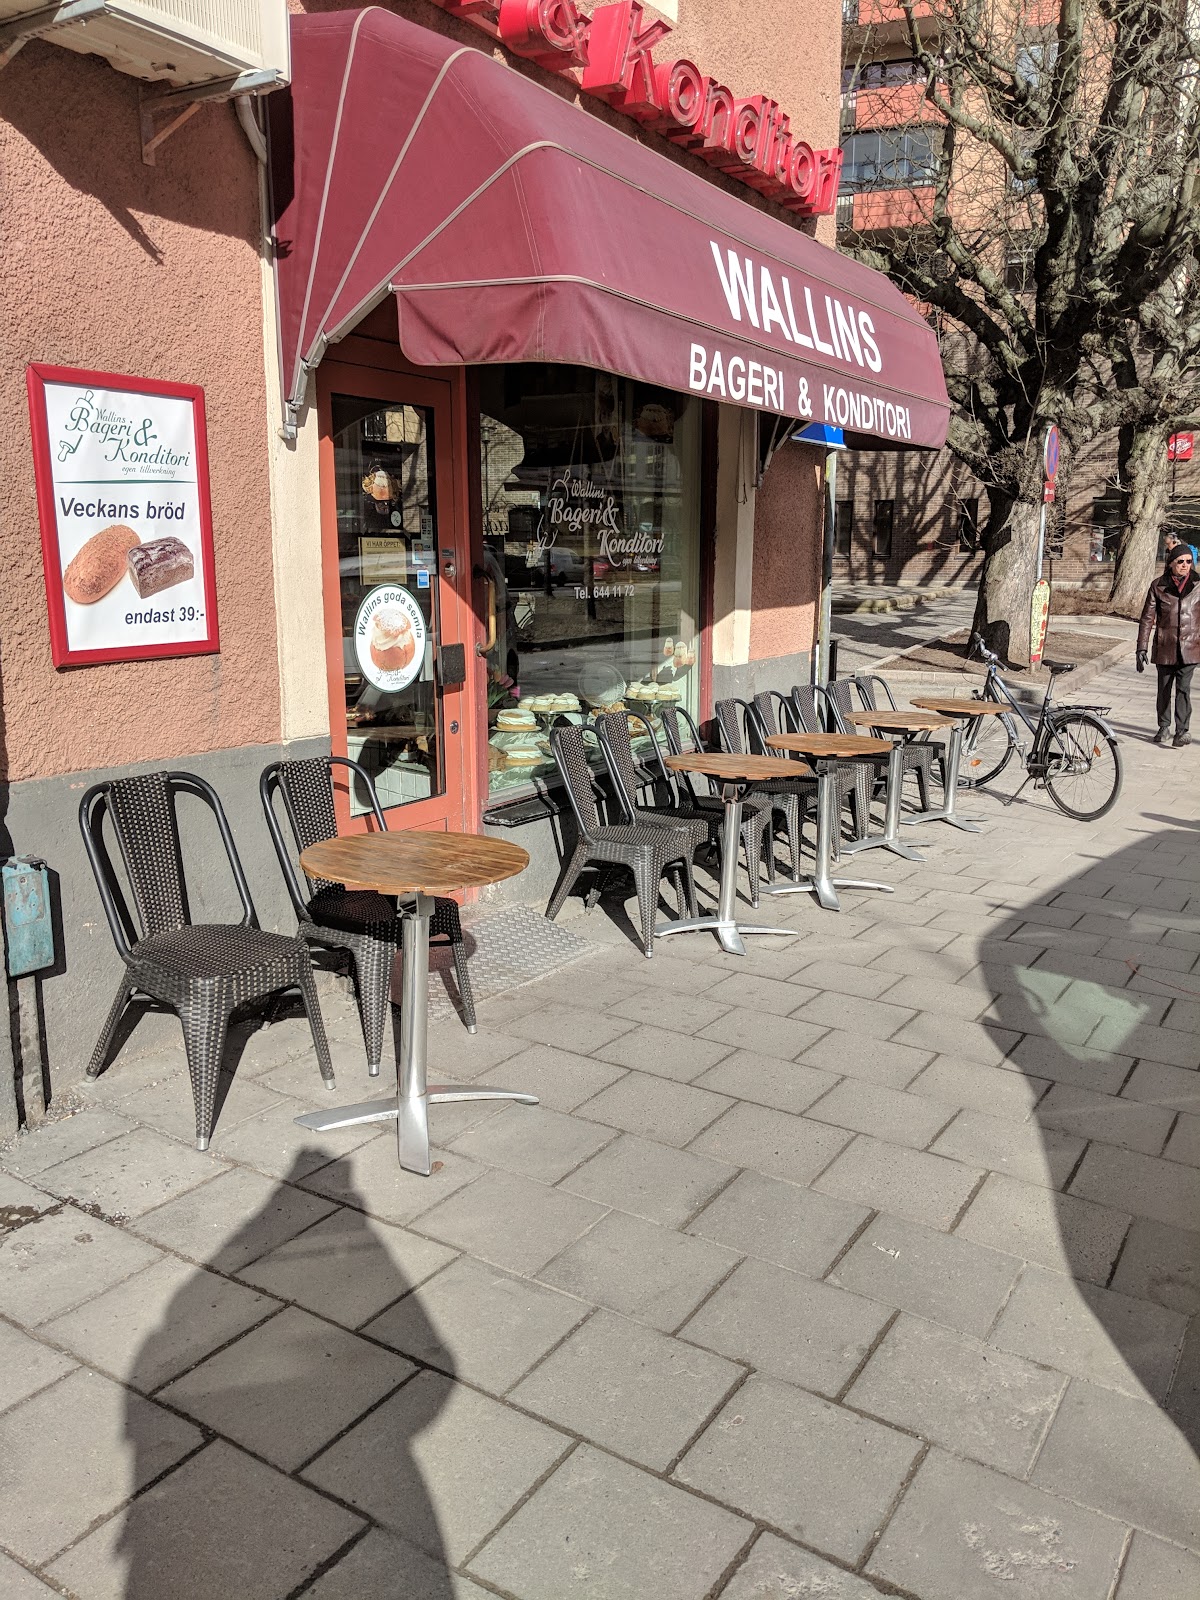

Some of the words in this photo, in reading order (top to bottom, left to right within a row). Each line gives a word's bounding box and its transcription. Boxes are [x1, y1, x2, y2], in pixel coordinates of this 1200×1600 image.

[582, 0, 843, 217] Konditori
[709, 240, 883, 374] WALLINS
[688, 343, 785, 412] BAGERI
[797, 376, 814, 418] &
[822, 383, 912, 440] KONDITORI
[64, 406, 134, 444] Bageri
[133, 418, 158, 447] &
[95, 407, 127, 424] Wallins
[104, 437, 191, 467] Konditori
[121, 466, 137, 475] egen
[139, 464, 176, 479] tillverkning
[571, 479, 606, 499] Wallins
[60, 497, 140, 519] Veckans
[146, 500, 186, 520] bröd
[547, 497, 603, 532] Bageri
[602, 496, 621, 534] &
[596, 528, 665, 567] Konditori
[573, 586, 591, 600] Tel.
[593, 585, 610, 599] 644
[612, 585, 622, 598] 11
[624, 584, 635, 597] 72
[124, 607, 176, 625] endast
[178, 606, 205, 622] 39:-
[358, 595, 382, 636] Wallins
[383, 592, 407, 605] goda
[406, 603, 423, 639] semla
